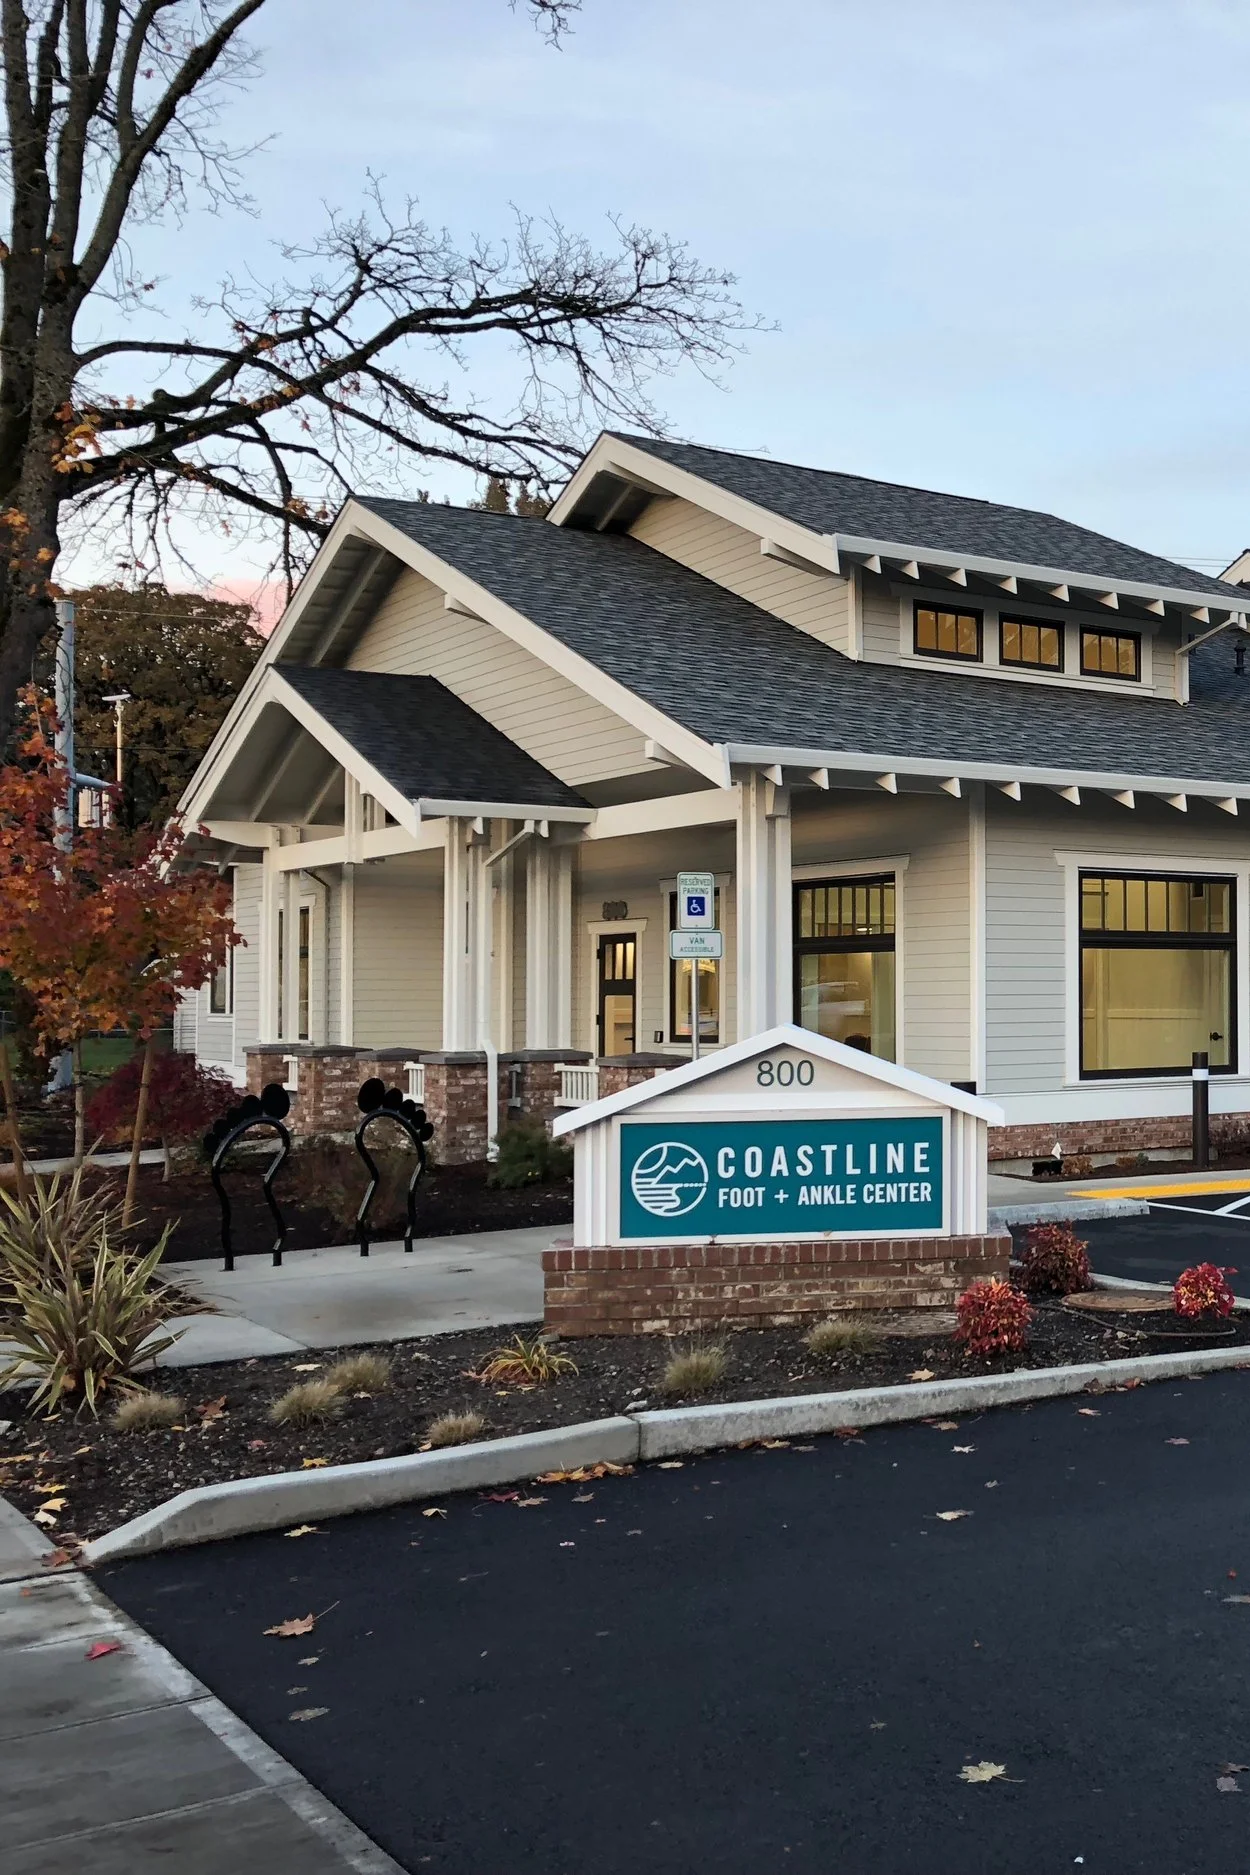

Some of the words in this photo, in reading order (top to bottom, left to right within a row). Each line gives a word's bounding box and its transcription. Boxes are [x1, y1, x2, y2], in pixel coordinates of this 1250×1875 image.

[680, 878, 711, 886] RESERVED
[682, 887, 709, 895] PARKING
[757, 1060, 814, 1086] 800
[717, 1142, 930, 1179] COASTLINE
[718, 1186, 766, 1208] FOOT
[774, 1189, 789, 1204] +
[798, 1184, 857, 1206] ANKLE
[863, 1182, 932, 1204] CENTER
